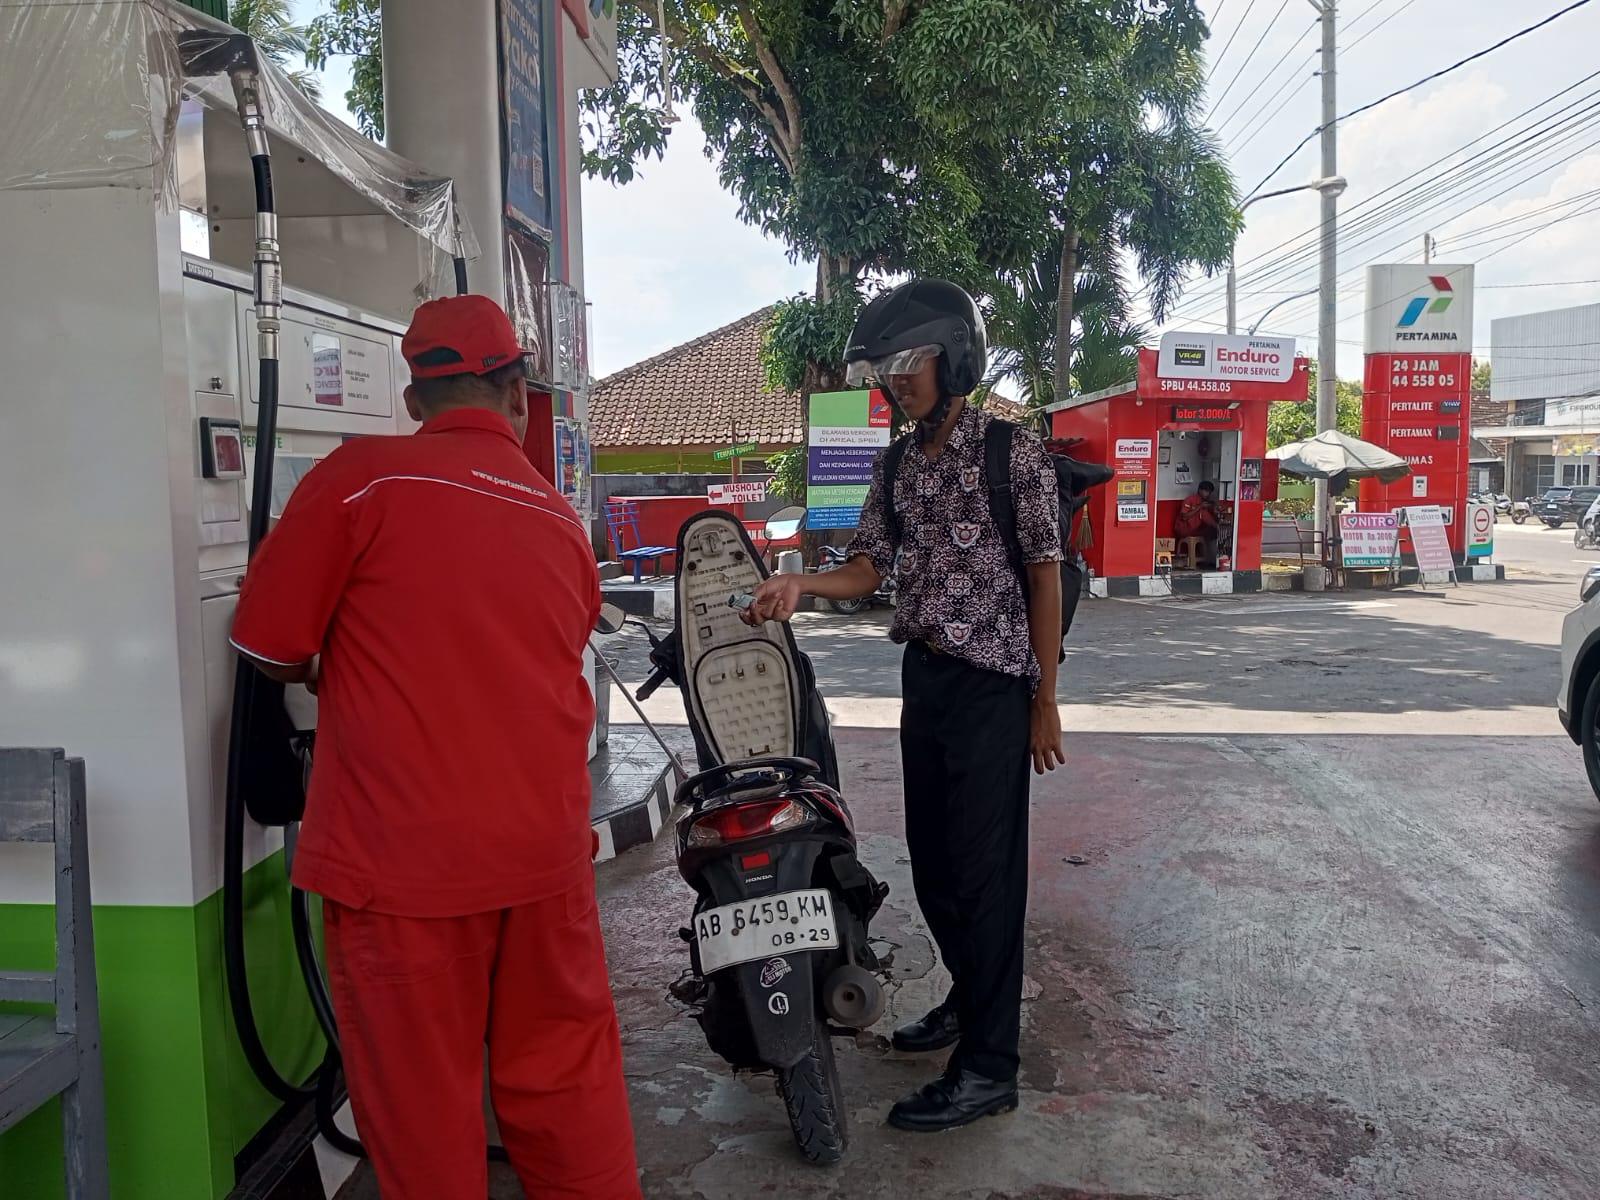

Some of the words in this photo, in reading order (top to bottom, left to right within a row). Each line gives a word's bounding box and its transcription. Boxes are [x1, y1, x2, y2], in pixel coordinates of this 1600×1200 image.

[1395, 332, 1458, 341] PERTAMINA
[1248, 341, 1280, 349] PERTAMINA
[1216, 347, 1281, 364] Enduro
[1392, 360, 1409, 372] 24
[1412, 359, 1439, 371] JAM
[1220, 366, 1249, 375] MOTOR
[1250, 366, 1280, 376] SERVICE
[1392, 375, 1409, 387] 44
[1412, 374, 1435, 386] 558
[1439, 374, 1455, 386] 05
[1161, 380, 1185, 391] SPBU
[1187, 381, 1231, 393] 44.558.05
[1391, 402, 1433, 411] PERTALITE
[1390, 428, 1433, 438] PERTAMAX
[723, 484, 763, 493] MUSHOLA
[732, 494, 763, 502] TOILET
[1358, 516, 1395, 526] NITRO
[745, 874, 774, 884] HONDA
[701, 914, 722, 940] AB
[735, 900, 789, 929] 6459
[798, 896, 828, 918] KM
